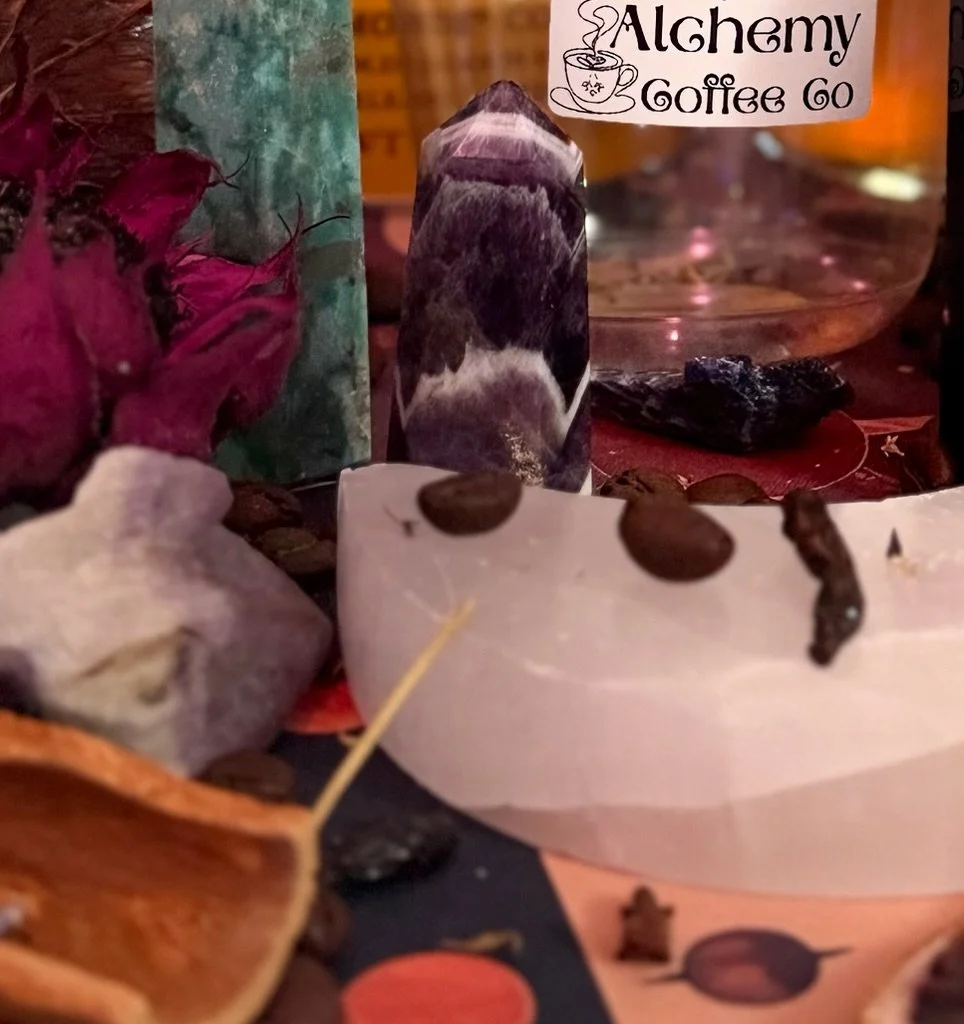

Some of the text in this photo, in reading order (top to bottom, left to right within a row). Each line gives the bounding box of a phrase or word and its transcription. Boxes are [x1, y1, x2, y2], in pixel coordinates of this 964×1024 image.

[609, 4, 862, 68] Alchemy
[640, 73, 854, 115] Coffee Co
